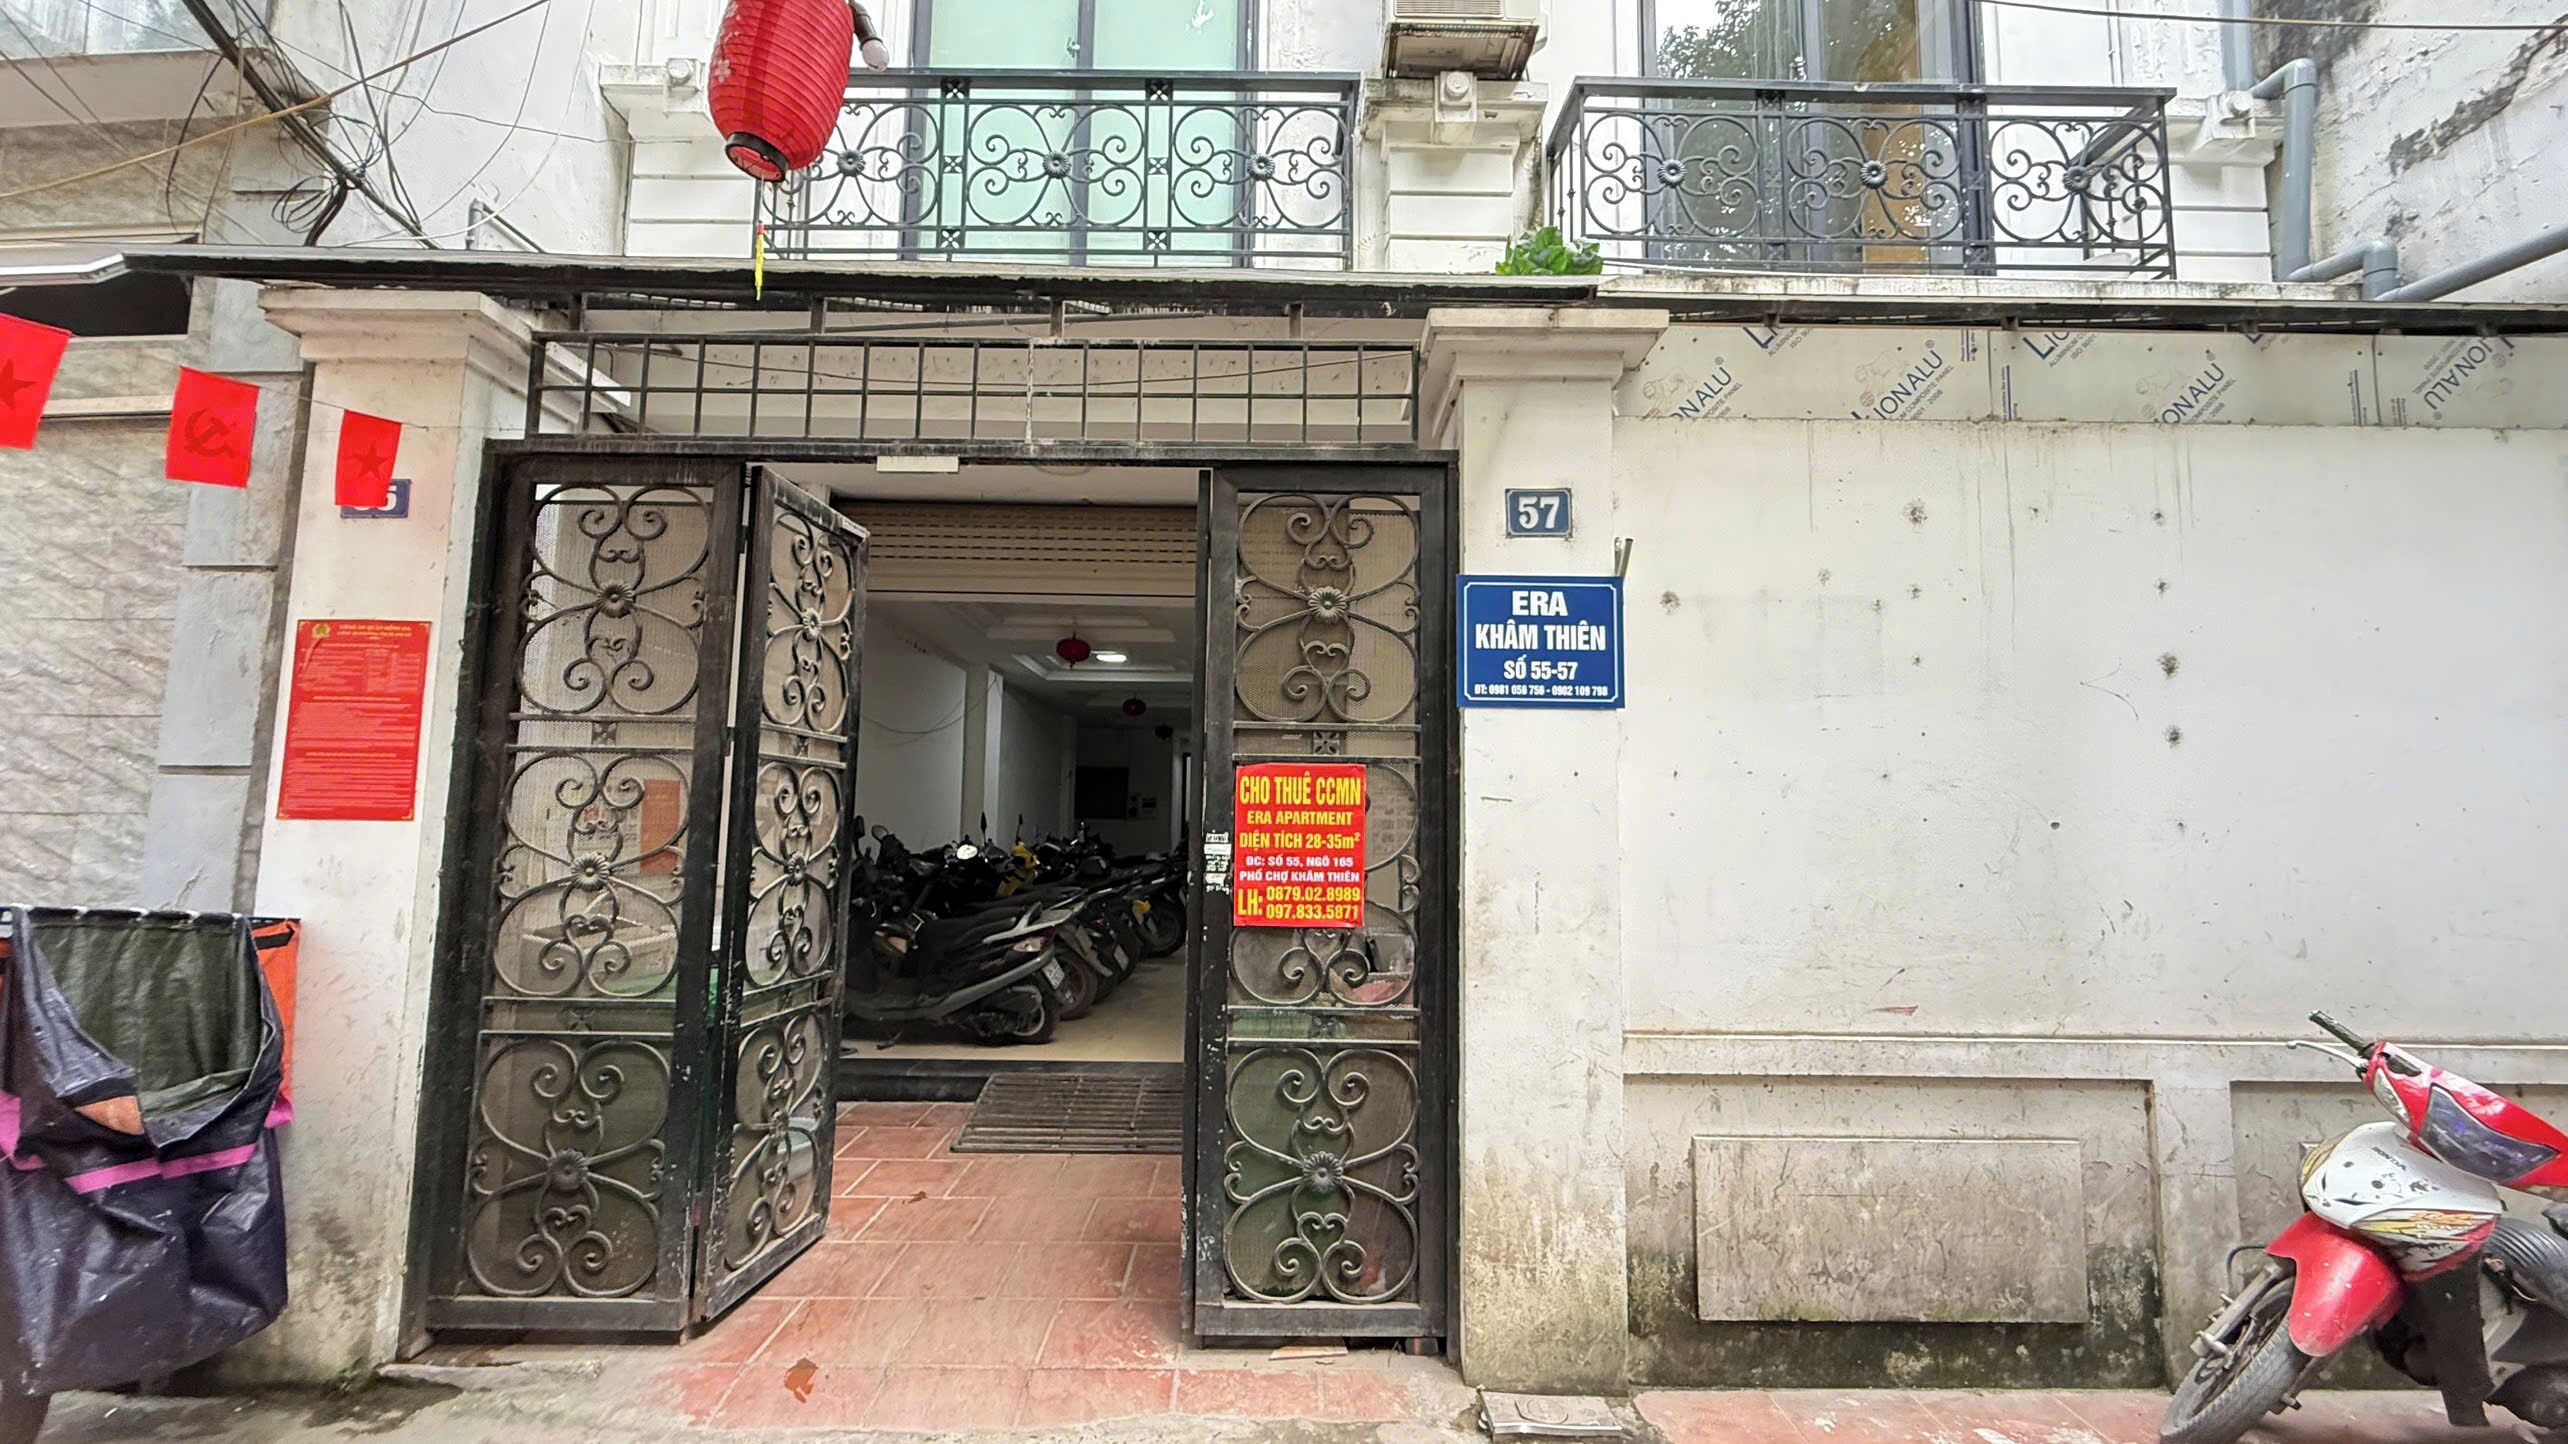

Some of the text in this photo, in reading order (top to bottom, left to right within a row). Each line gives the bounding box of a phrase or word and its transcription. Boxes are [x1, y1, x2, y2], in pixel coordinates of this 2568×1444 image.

[1518, 496, 1560, 529] 57
[1512, 591, 1568, 616] ERA
[1475, 619, 1606, 651] KHÂM THIÊN
[1504, 654, 1579, 681] SỐ 55-57
[1240, 771, 1361, 805] CHO THUÊ CCMN
[1247, 811, 1353, 825] ERA APARTMENT
[1240, 829, 1270, 852] DIỆN
[1273, 829, 1302, 849] TÍCH
[1268, 853, 1284, 867] SỐ
[1333, 856, 1353, 867] 165
[1240, 868, 1359, 883] PHỐ CHỢ KHÂM THIÊN
[1238, 888, 1263, 916] LH:
[1266, 886, 1360, 901] 0879.02.8989
[1266, 904, 1359, 920] 097.833.5871
